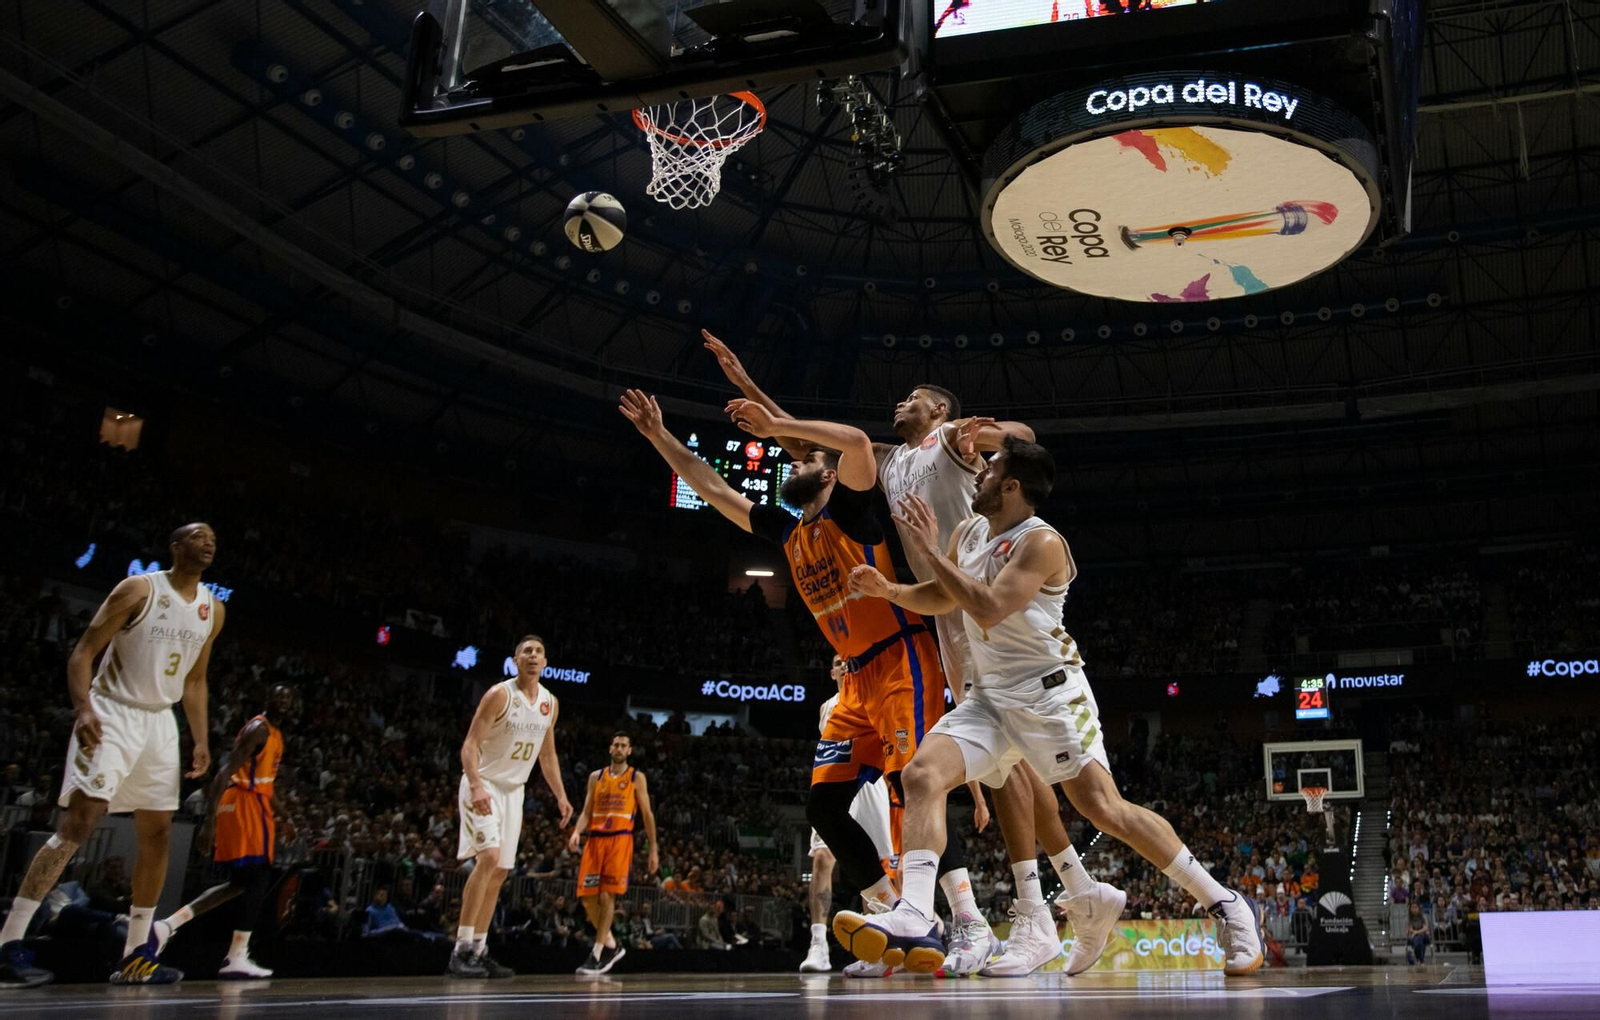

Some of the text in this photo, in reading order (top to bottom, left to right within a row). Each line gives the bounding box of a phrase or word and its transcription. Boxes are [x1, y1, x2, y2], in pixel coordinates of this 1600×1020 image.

[1085, 79, 1299, 120] Copa del Rey
[1036, 211, 1073, 265] del Rey
[1068, 208, 1110, 258] Copa
[1021, 240, 1038, 258] 2020
[726, 440, 782, 458] 57 37
[746, 461, 761, 471] 3T
[741, 477, 769, 492] 4:35
[759, 494, 769, 505] 2
[828, 614, 849, 641] 14
[164, 652, 181, 677] 3
[1526, 659, 1599, 678] #Copa
[1300, 678, 1324, 688] 4:35
[1339, 673, 1405, 689] movistar
[701, 679, 806, 703] #CopaACB
[1298, 691, 1323, 709] 24
[510, 741, 535, 762] 20
[1325, 926, 1350, 935] Unicaja
